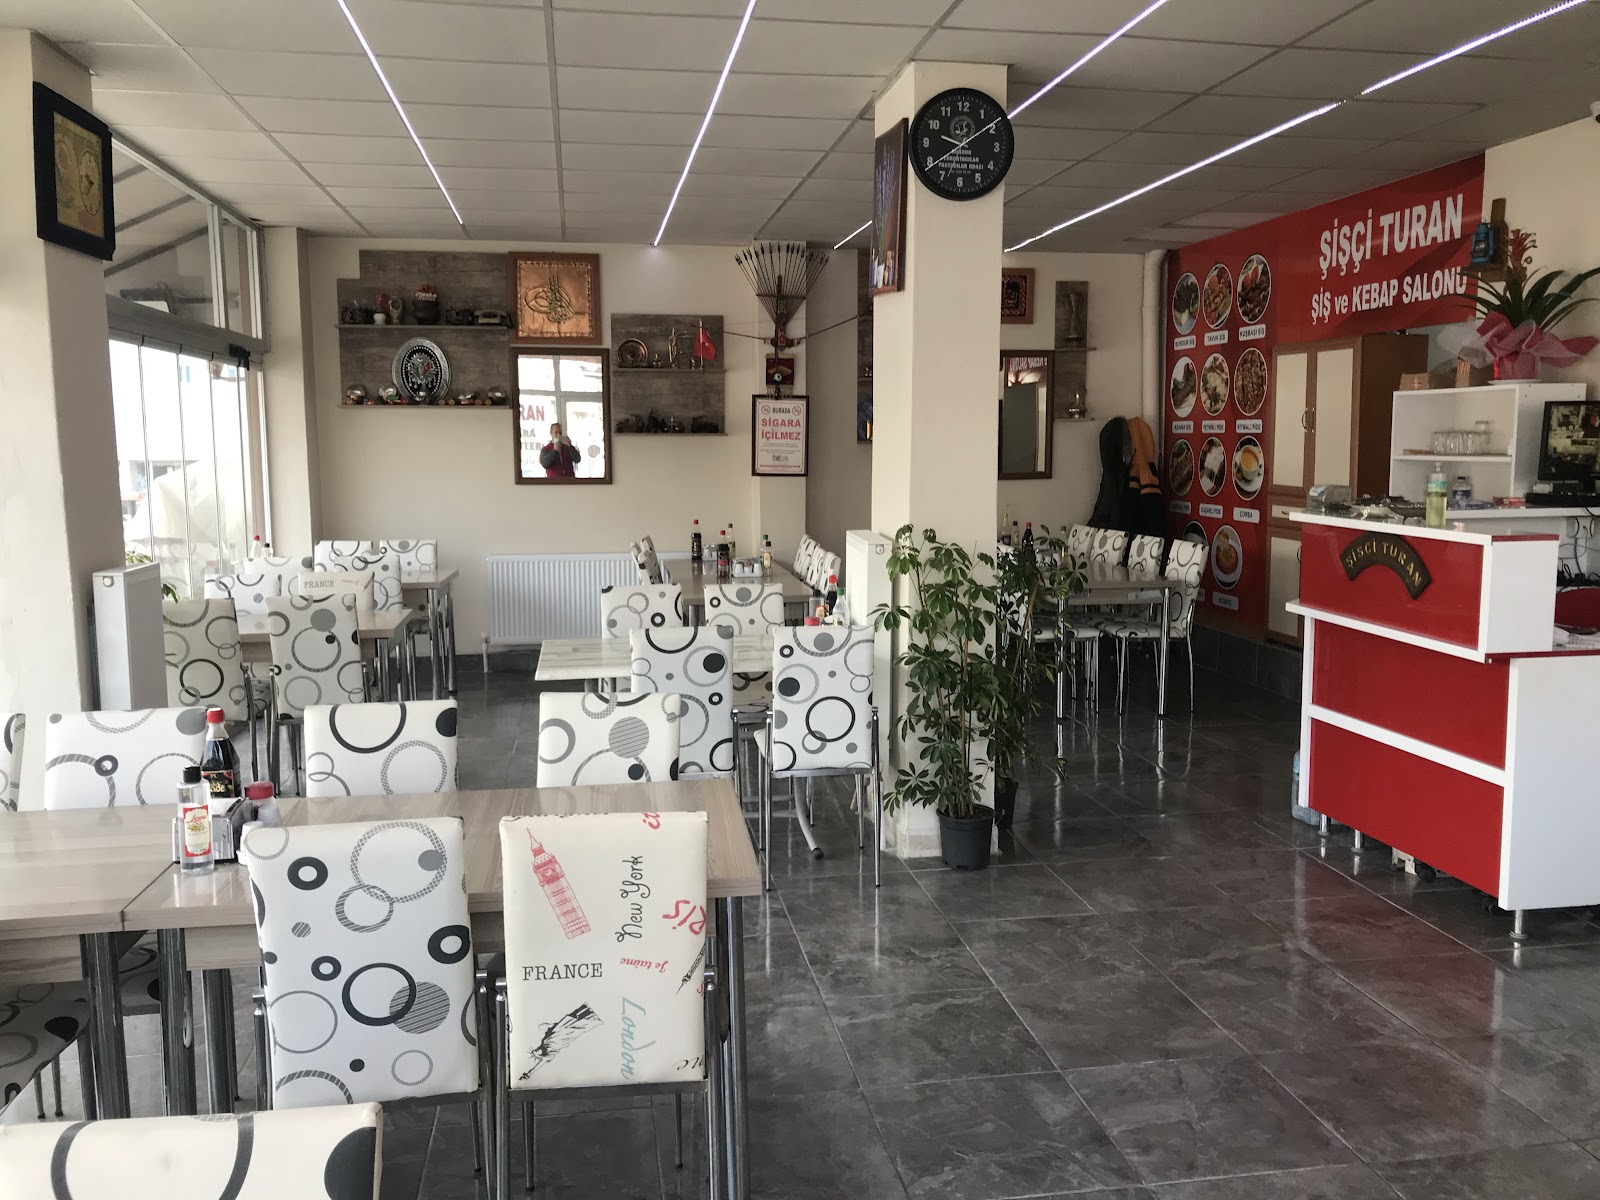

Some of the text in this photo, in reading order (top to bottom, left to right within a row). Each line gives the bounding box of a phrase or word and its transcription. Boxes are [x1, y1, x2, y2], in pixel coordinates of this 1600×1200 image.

[941, 106, 951, 117] 11
[957, 102, 970, 112] 12
[979, 109, 985, 119] 1
[928, 120, 940, 130] 10
[989, 124, 996, 134] 2
[923, 138, 930, 148] 9
[994, 142, 1000, 152] 3
[927, 157, 933, 167] 8
[988, 161, 994, 171] 4
[939, 171, 946, 181] 7
[975, 173, 981, 183] 5
[957, 177, 963, 187] 6
[1319, 193, 1463, 280] ŞİŞÇİ TURAN
[1311, 266, 1468, 325] ŞİŞ ve KEBAP SALONU
[762, 417, 801, 428] SİGARA
[762, 429, 801, 441] İÇİLMEZ
[1382, 542, 1422, 587] TURAN
[615, 855, 651, 943] New York
[522, 963, 603, 981] FRANCE
[654, 960, 669, 974] Je
[620, 997, 657, 1080] London
